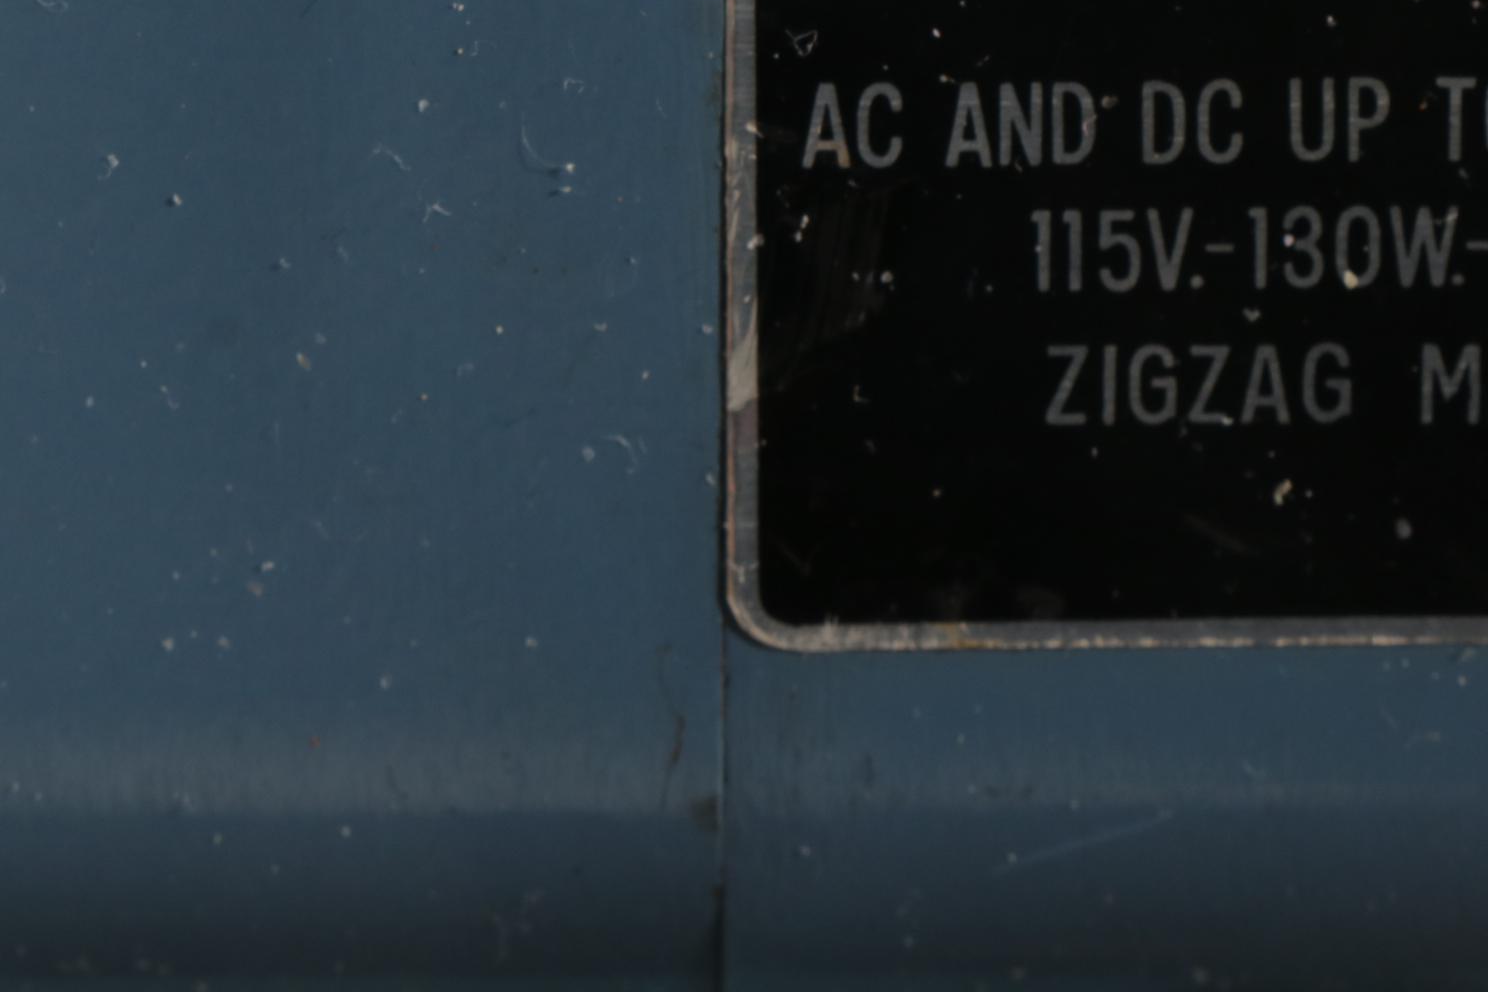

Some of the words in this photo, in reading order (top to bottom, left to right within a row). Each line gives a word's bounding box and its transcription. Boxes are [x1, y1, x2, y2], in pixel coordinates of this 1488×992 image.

[802, 81, 903, 169] AC
[944, 81, 1096, 169] AND
[1141, 78, 1245, 165] DC
[1288, 75, 1391, 162] UP
[1045, 343, 1353, 426] ZIGZAG
